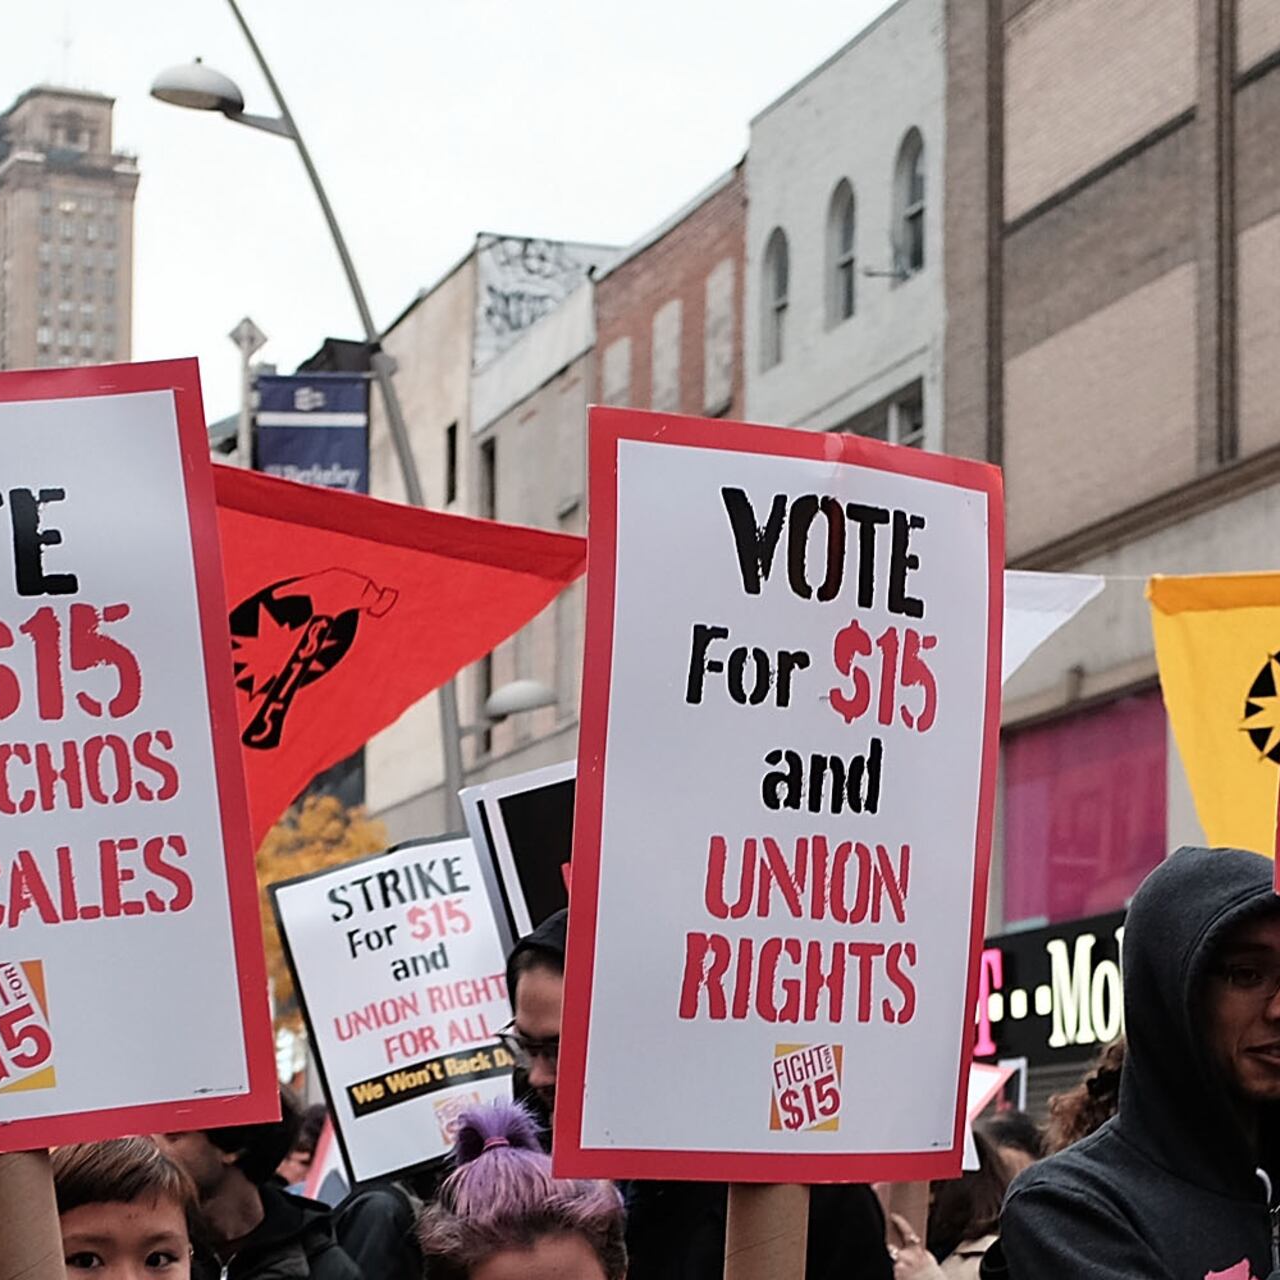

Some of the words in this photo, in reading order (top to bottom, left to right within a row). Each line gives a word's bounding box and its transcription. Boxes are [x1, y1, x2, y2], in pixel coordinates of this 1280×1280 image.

[721, 487, 926, 620] VOTE
[686, 624, 810, 709] For
[829, 619, 938, 734] $15
[760, 738, 883, 815] and
[326, 856, 471, 923] STRIKE
[704, 834, 911, 923] UNION
[346, 922, 398, 959] For
[406, 898, 472, 943] $15
[3, 966, 28, 1000] FOR
[390, 942, 450, 982] and
[679, 932, 918, 1025] RIGHTS
[333, 991, 419, 1042] UNION
[384, 1027, 440, 1064] FOR
[447, 1013, 496, 1048] ALL
[351, 1081, 385, 1105] We
[385, 1062, 444, 1098] Won't
[445, 1050, 492, 1077] Back
[773, 1043, 828, 1090] FIGHT
[822, 1046, 834, 1072] FOR
[780, 1073, 841, 1131] $15
